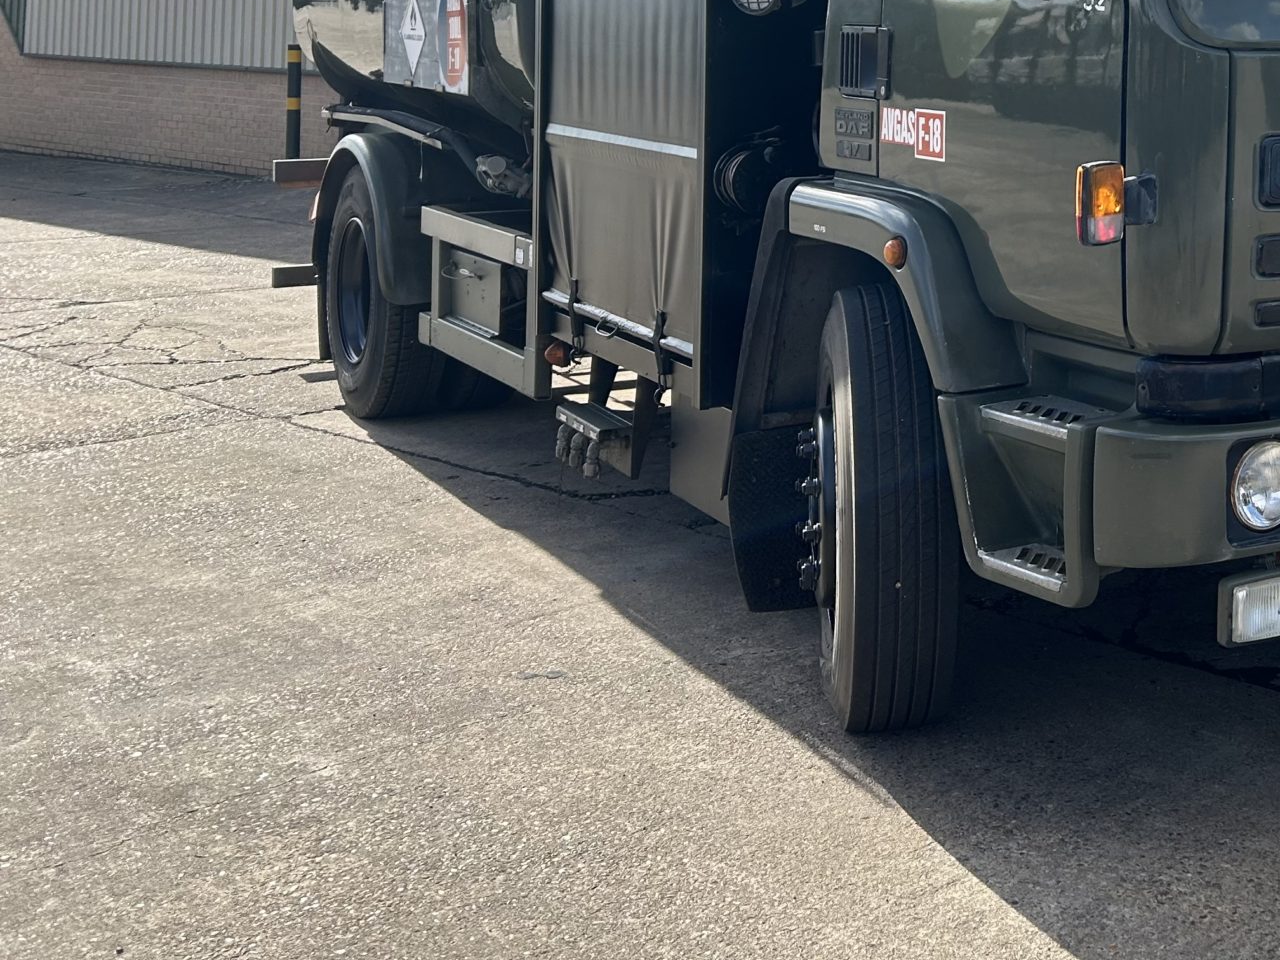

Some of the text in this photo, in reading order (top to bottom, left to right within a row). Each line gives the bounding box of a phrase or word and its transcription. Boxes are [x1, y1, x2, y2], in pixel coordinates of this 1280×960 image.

[836, 120, 868, 136] DAF
[881, 107, 942, 153] AVGAS F-18
